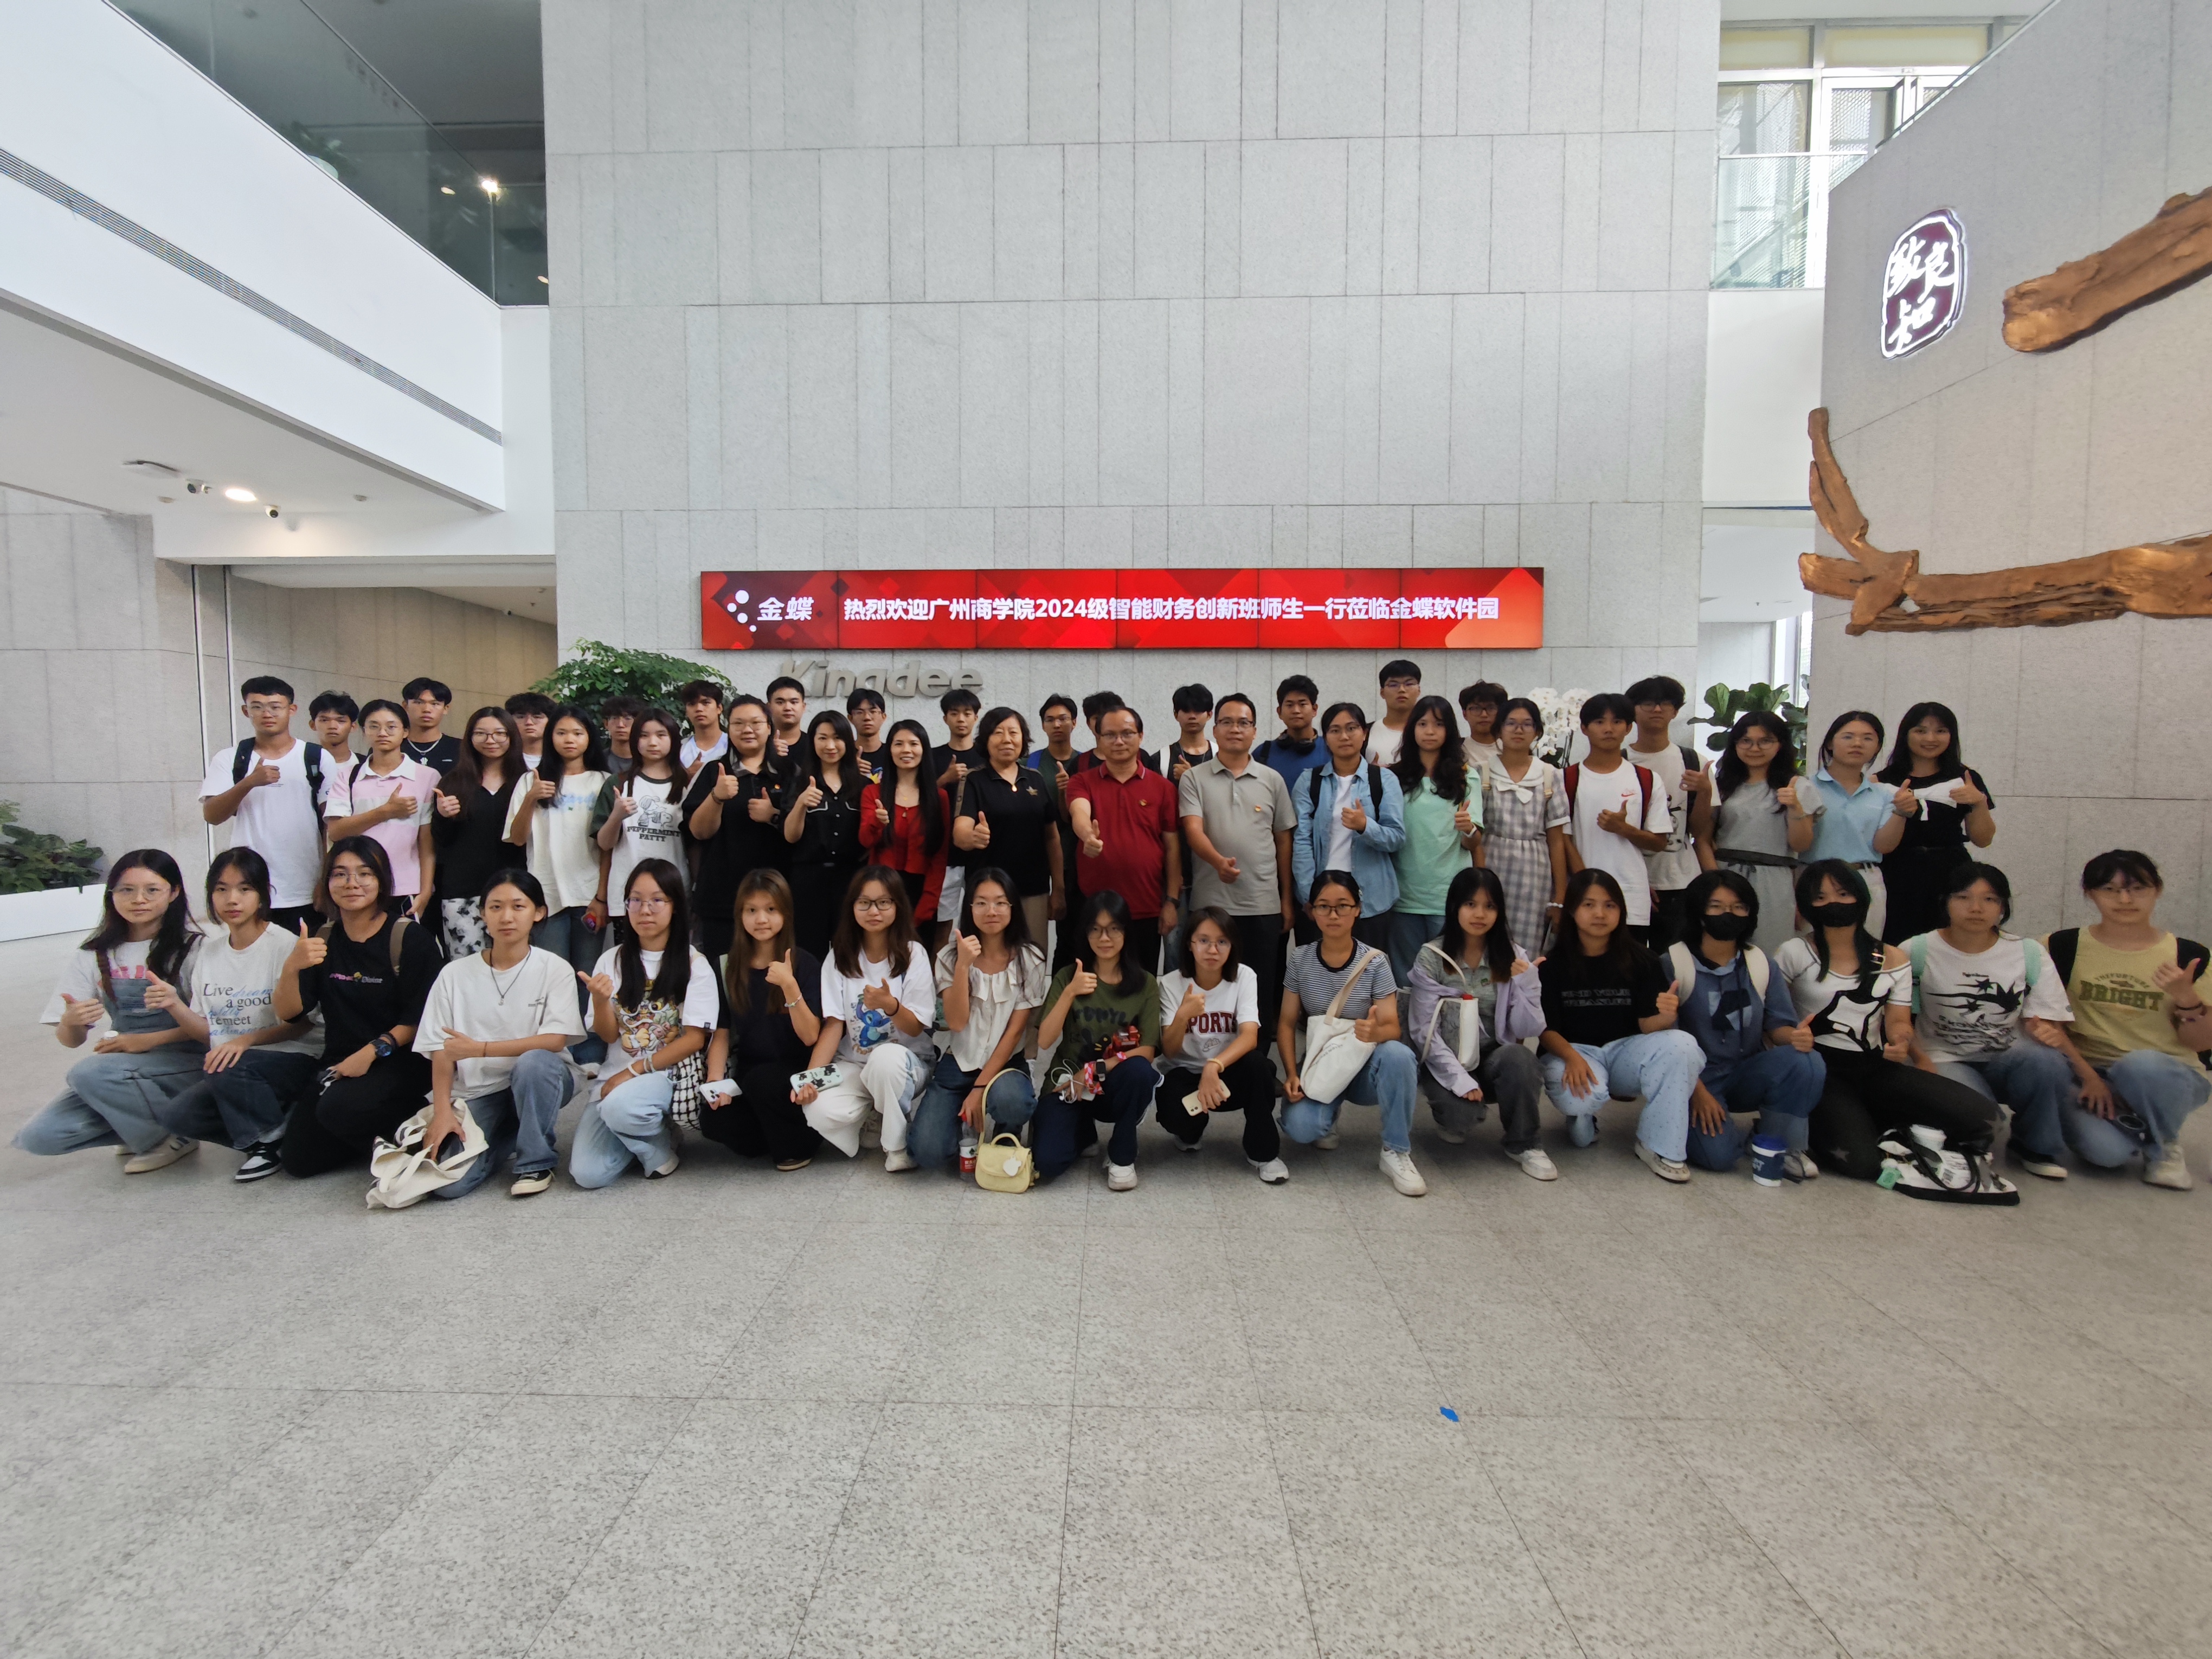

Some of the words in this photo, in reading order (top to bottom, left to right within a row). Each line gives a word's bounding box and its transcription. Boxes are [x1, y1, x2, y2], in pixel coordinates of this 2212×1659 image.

[757, 596, 814, 621] 金蝶
[844, 597, 1499, 621] 热烈欢迎广州商学院2024级智能财务创新班师生一行莅临金蝶软件园
[627, 826, 680, 837] PEPPERMINT
[203, 983, 233, 996] Live
[2079, 980, 2164, 1012] BRIGHT
[227, 999, 233, 1008] a
[237, 993, 272, 1011] good
[1185, 1012, 1238, 1035] PORT
